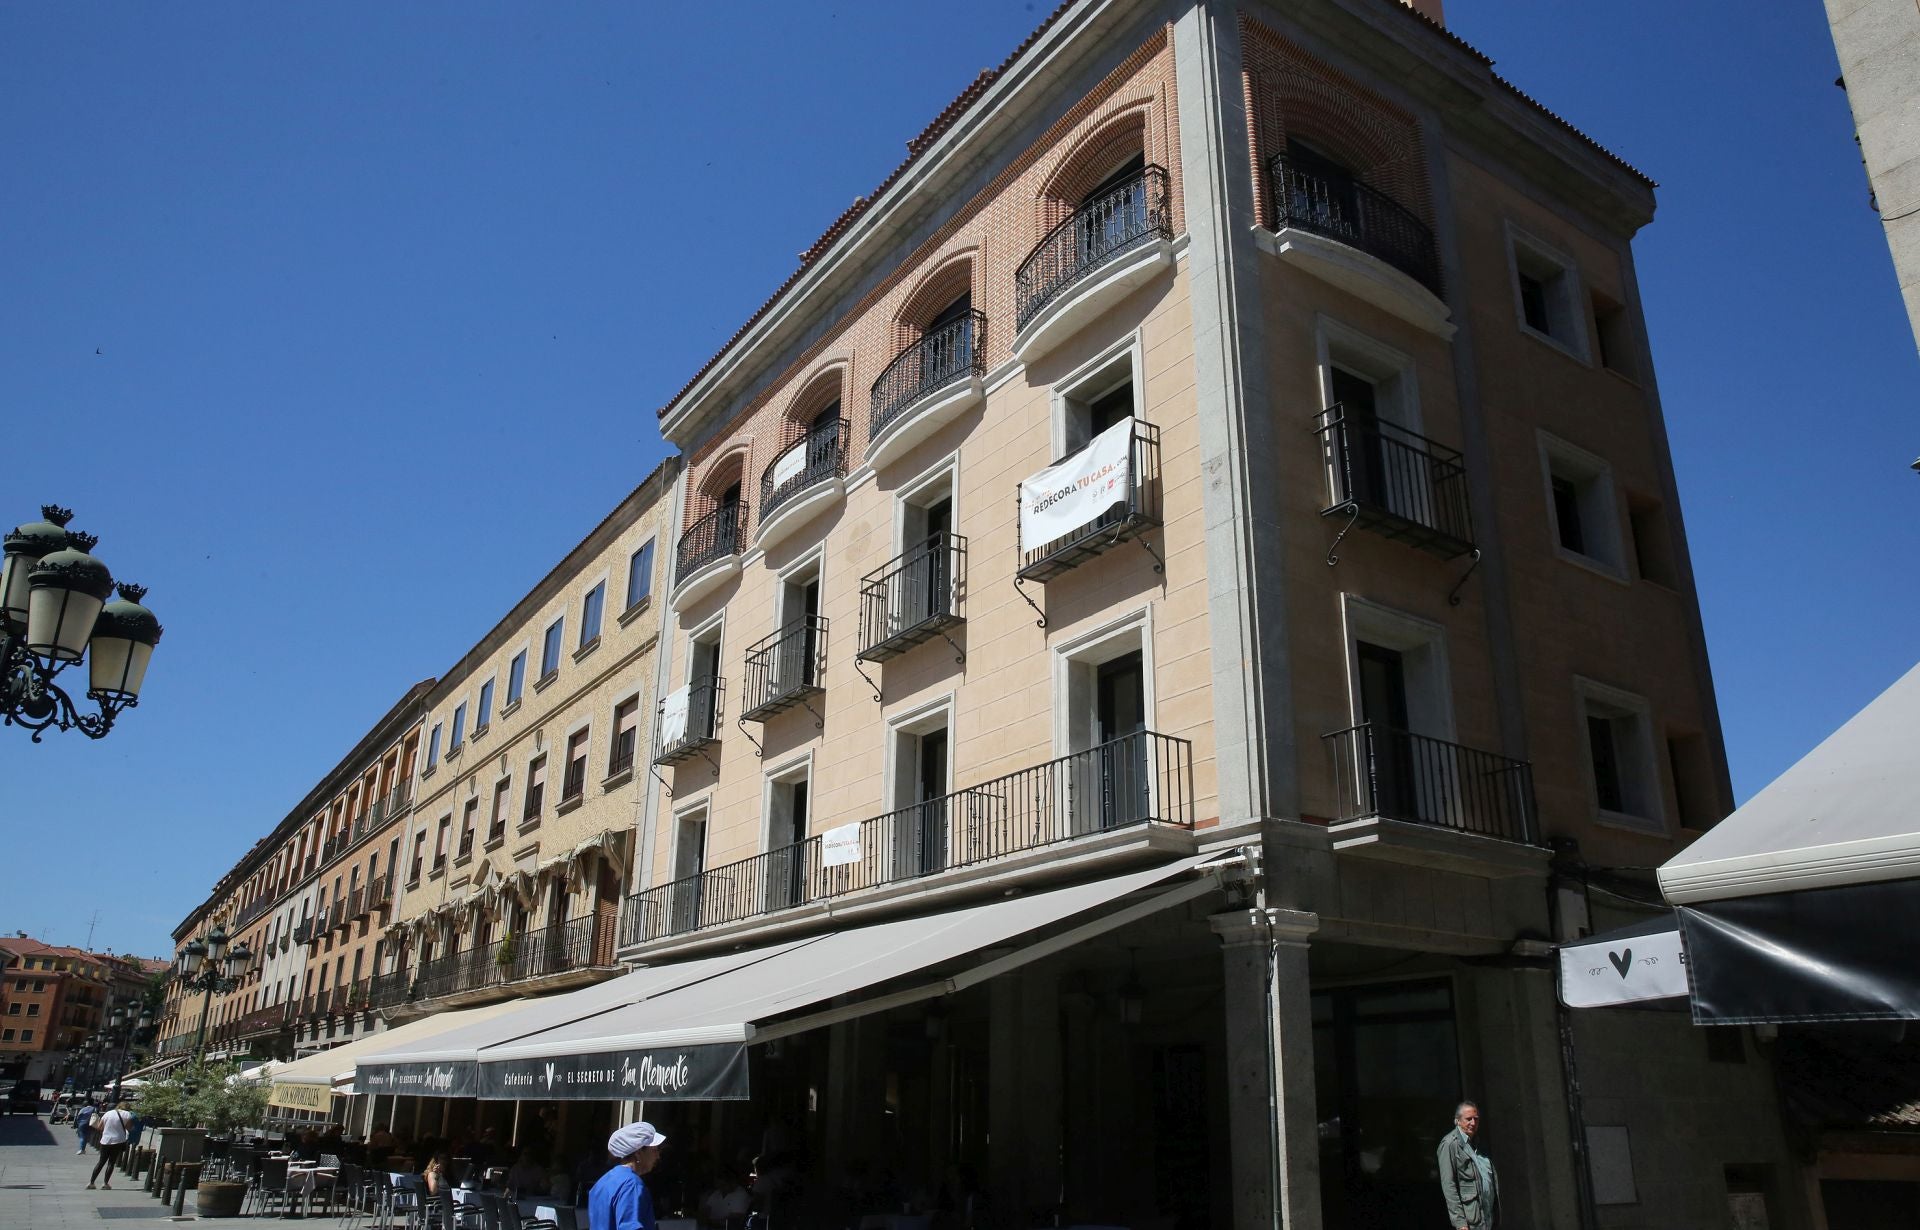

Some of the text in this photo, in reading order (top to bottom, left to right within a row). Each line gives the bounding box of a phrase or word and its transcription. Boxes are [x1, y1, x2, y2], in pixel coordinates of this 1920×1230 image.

[1033, 483, 1077, 514] REDECORA
[1077, 476, 1090, 490] TU
[504, 1071, 533, 1086] Cafetería
[567, 1071, 574, 1084] EL
[577, 1069, 604, 1083] SECRETO
[606, 1069, 616, 1082] DE
[639, 1054, 689, 1094] Clemente
